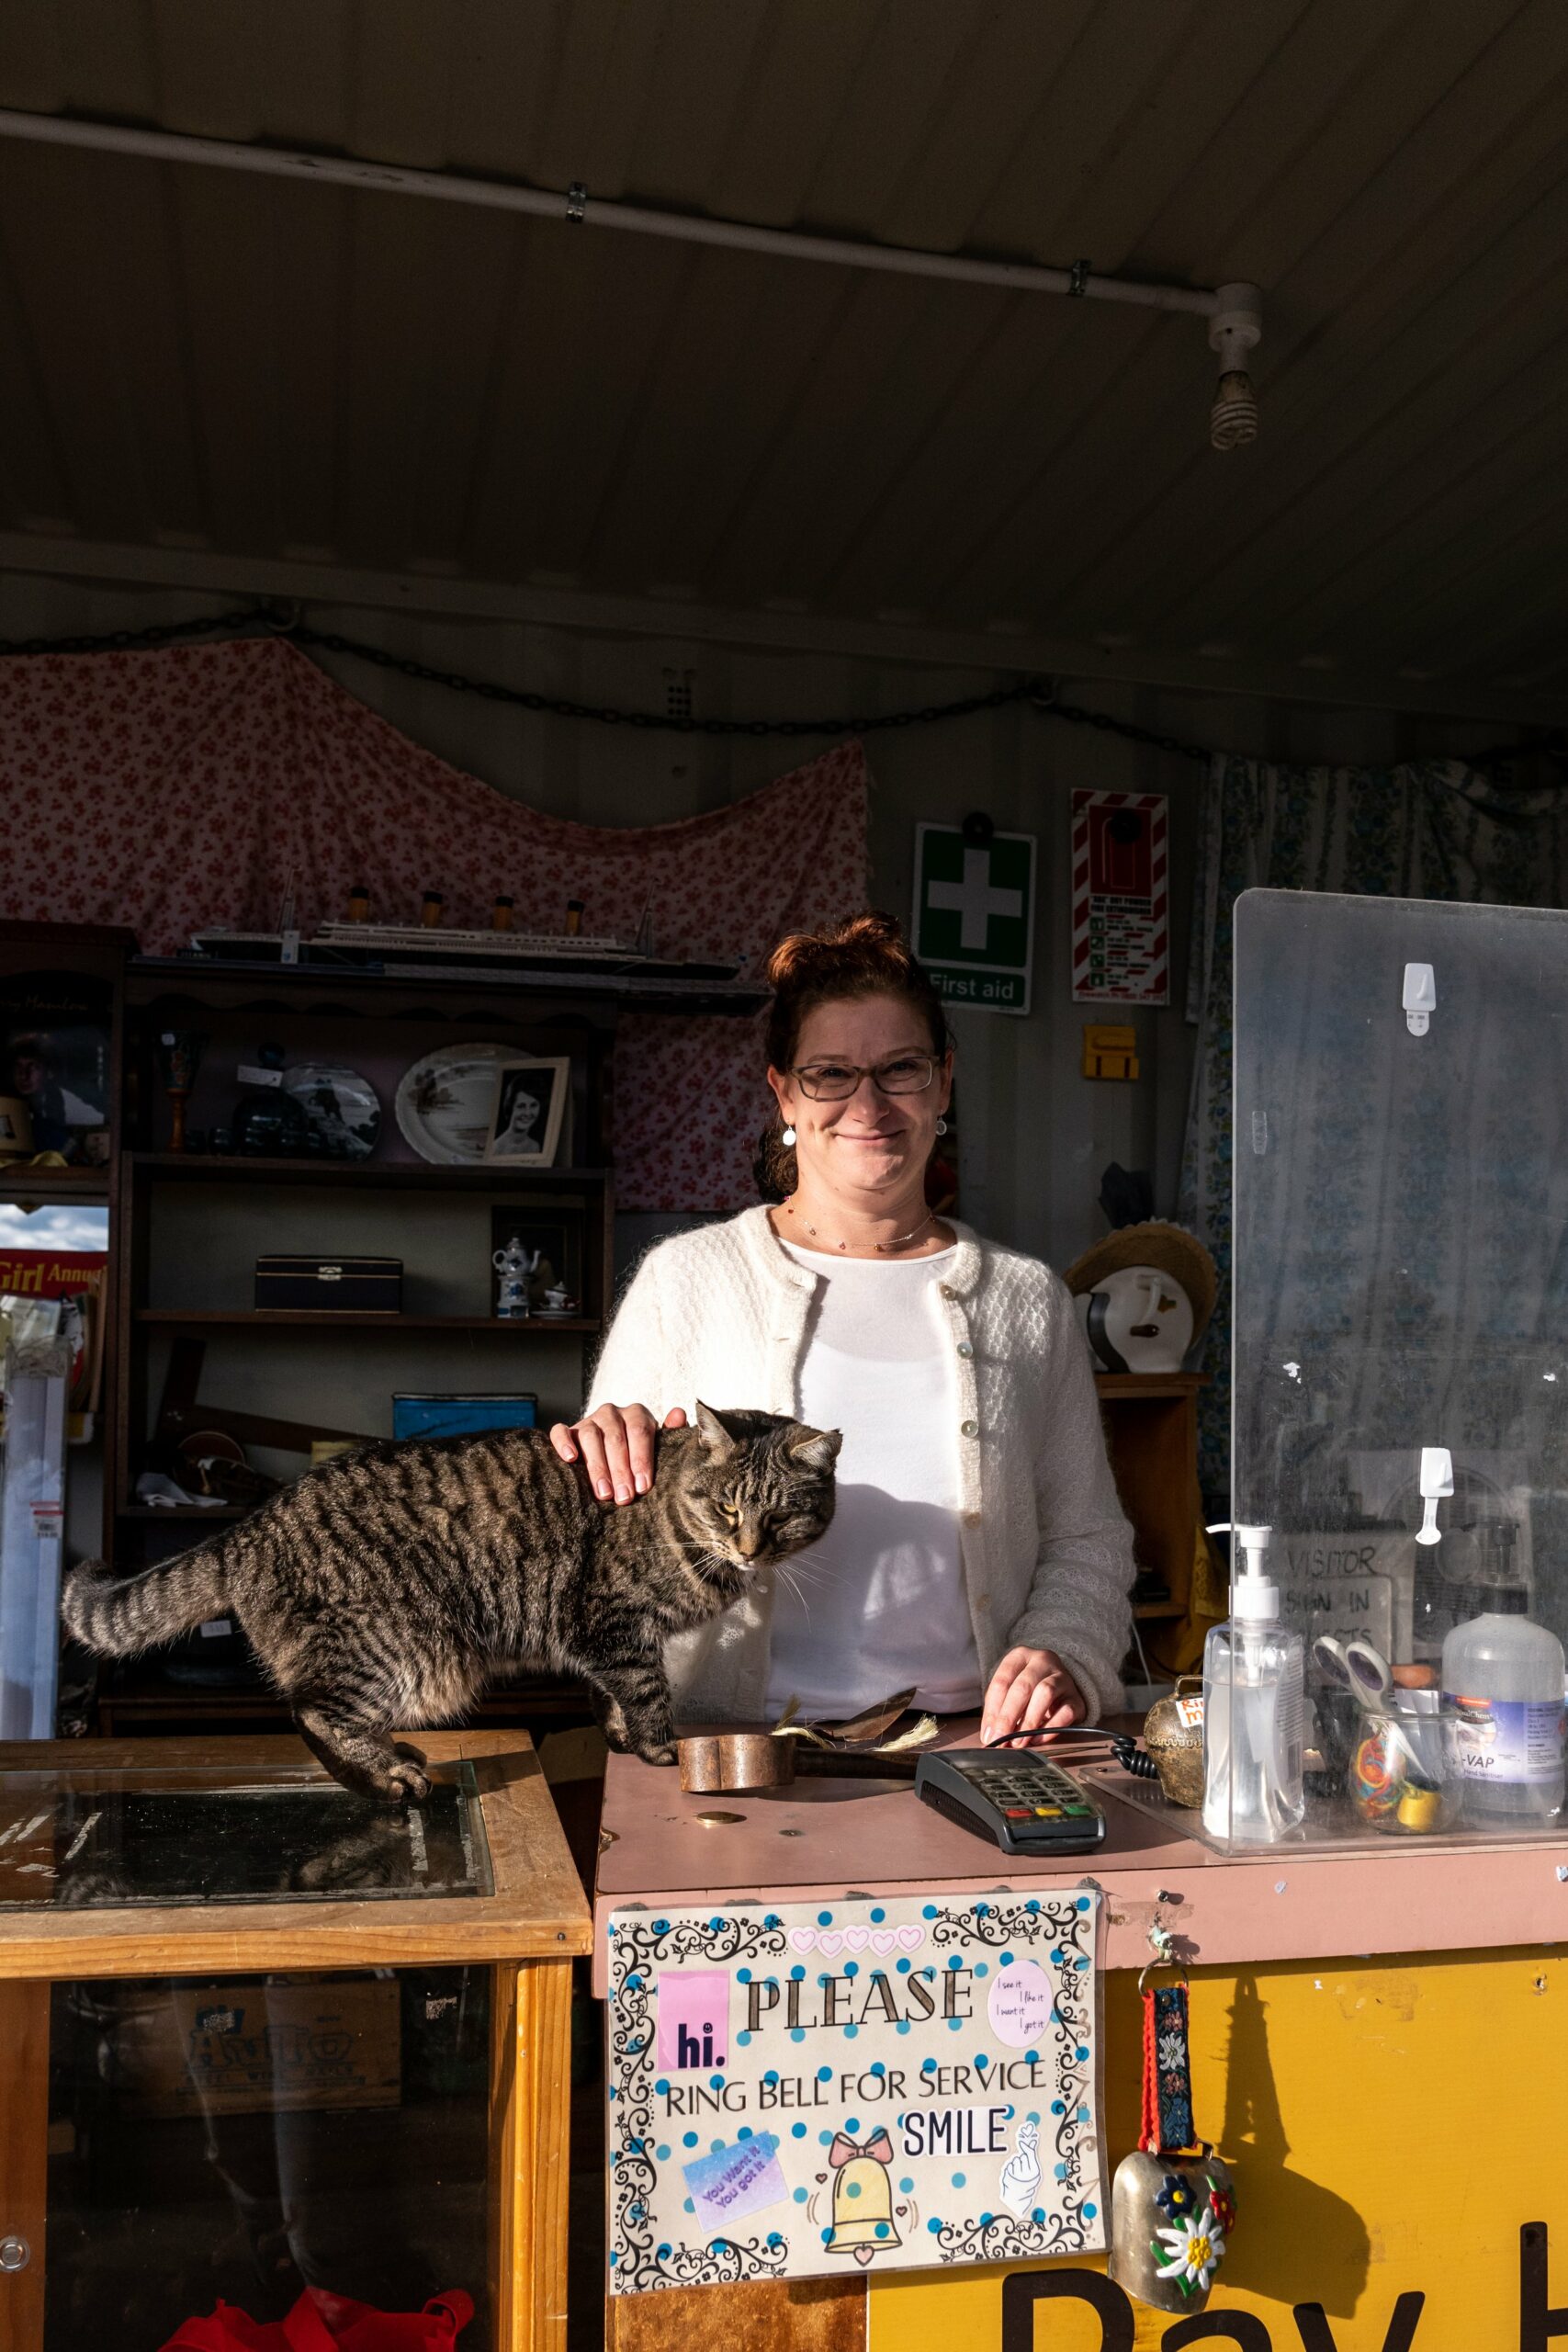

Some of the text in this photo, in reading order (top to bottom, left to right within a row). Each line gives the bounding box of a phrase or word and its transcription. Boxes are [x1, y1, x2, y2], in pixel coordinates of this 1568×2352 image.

[930, 974, 1014, 1000] First aid
[1288, 1547, 1378, 1577] VISITOR
[1349, 1589, 1371, 1612] IN
[1016, 1980, 1022, 1989] it
[1024, 1991, 1036, 2005] like
[1037, 1994, 1044, 2002] it
[744, 1969, 974, 2032] PLEASE
[1000, 2007, 1017, 2016] want
[1018, 2007, 1025, 2015] it
[1024, 2021, 1036, 2034] got
[1037, 2020, 1044, 2029] it
[678, 2022, 726, 2069] hi.
[666, 2060, 1047, 2118] RING BELL FOR SERVICE
[905, 2108, 1008, 2157] SMILE
[716, 2188, 739, 2209] You
[738, 2169, 757, 2192] got
